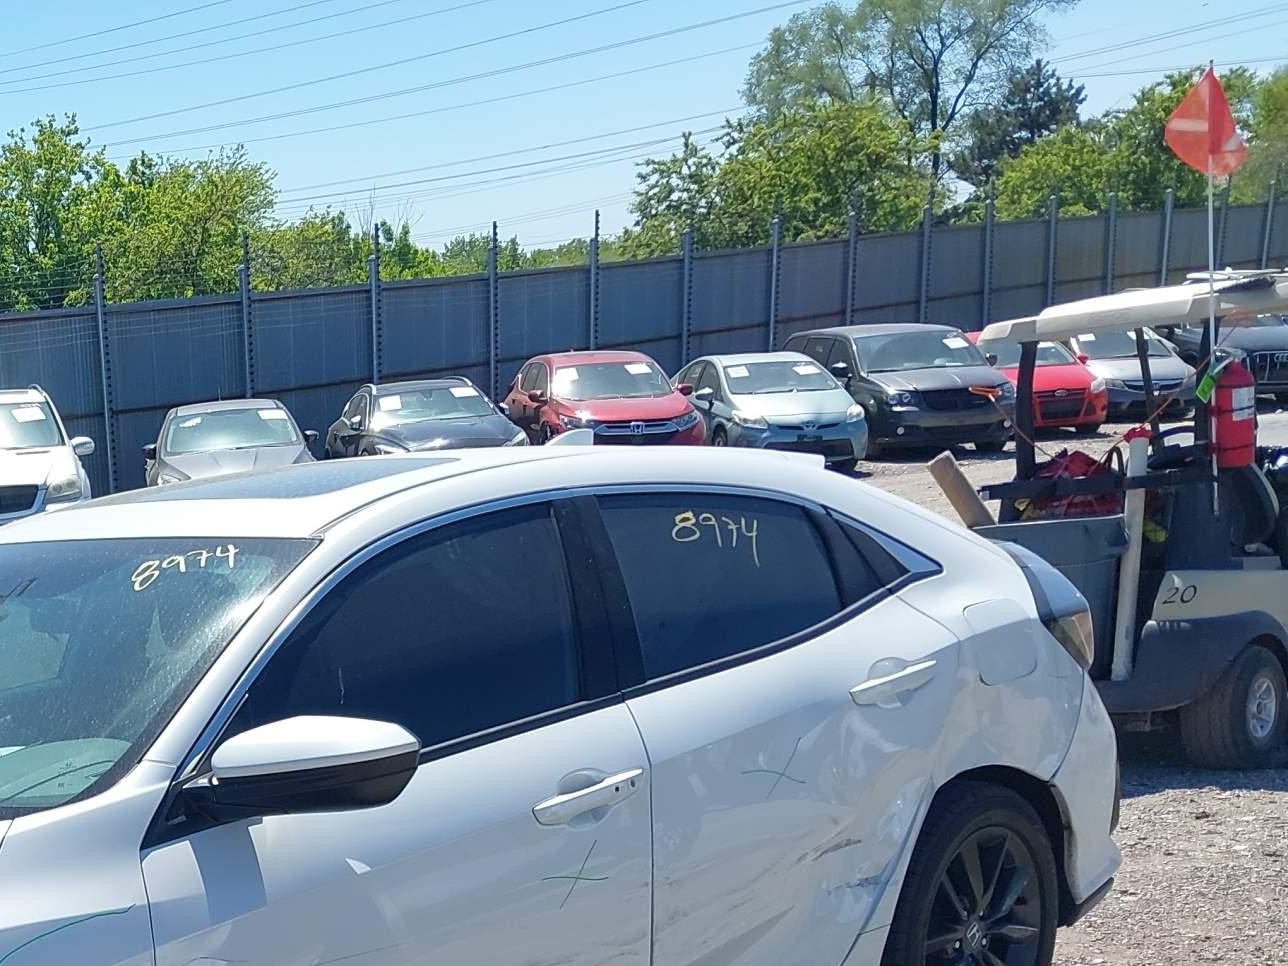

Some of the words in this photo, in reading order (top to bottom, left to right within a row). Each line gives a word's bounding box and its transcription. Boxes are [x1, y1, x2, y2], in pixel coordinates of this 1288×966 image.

[672, 510, 761, 568] 8974
[131, 543, 239, 592] 8974
[1162, 584, 1198, 605] 20
